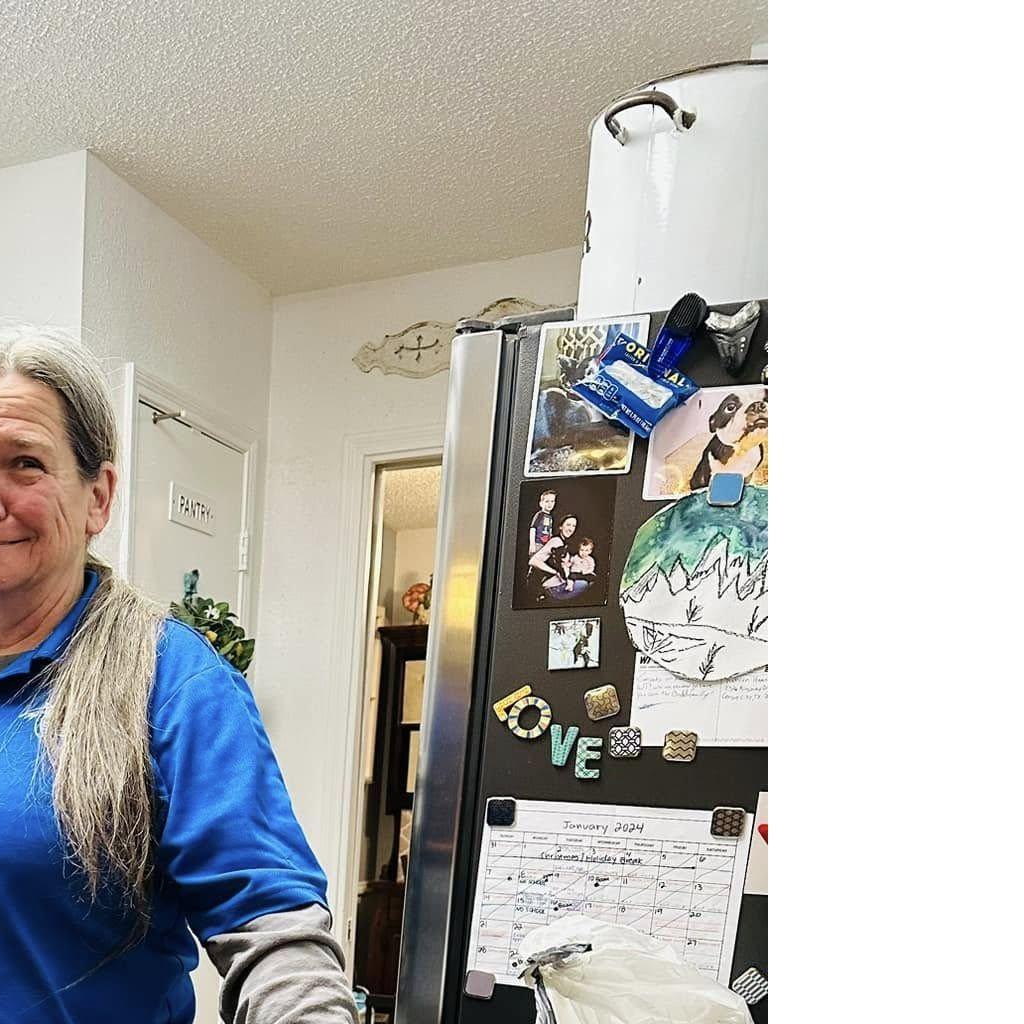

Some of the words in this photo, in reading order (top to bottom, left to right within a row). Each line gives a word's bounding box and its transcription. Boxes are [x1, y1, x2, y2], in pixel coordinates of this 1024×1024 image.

[178, 494, 210, 523] PANTRY
[493, 685, 603, 779] LOVE
[563, 820, 608, 835] January
[615, 821, 645, 834] 2024
[658, 881, 666, 889] 12
[694, 883, 703, 891] 13
